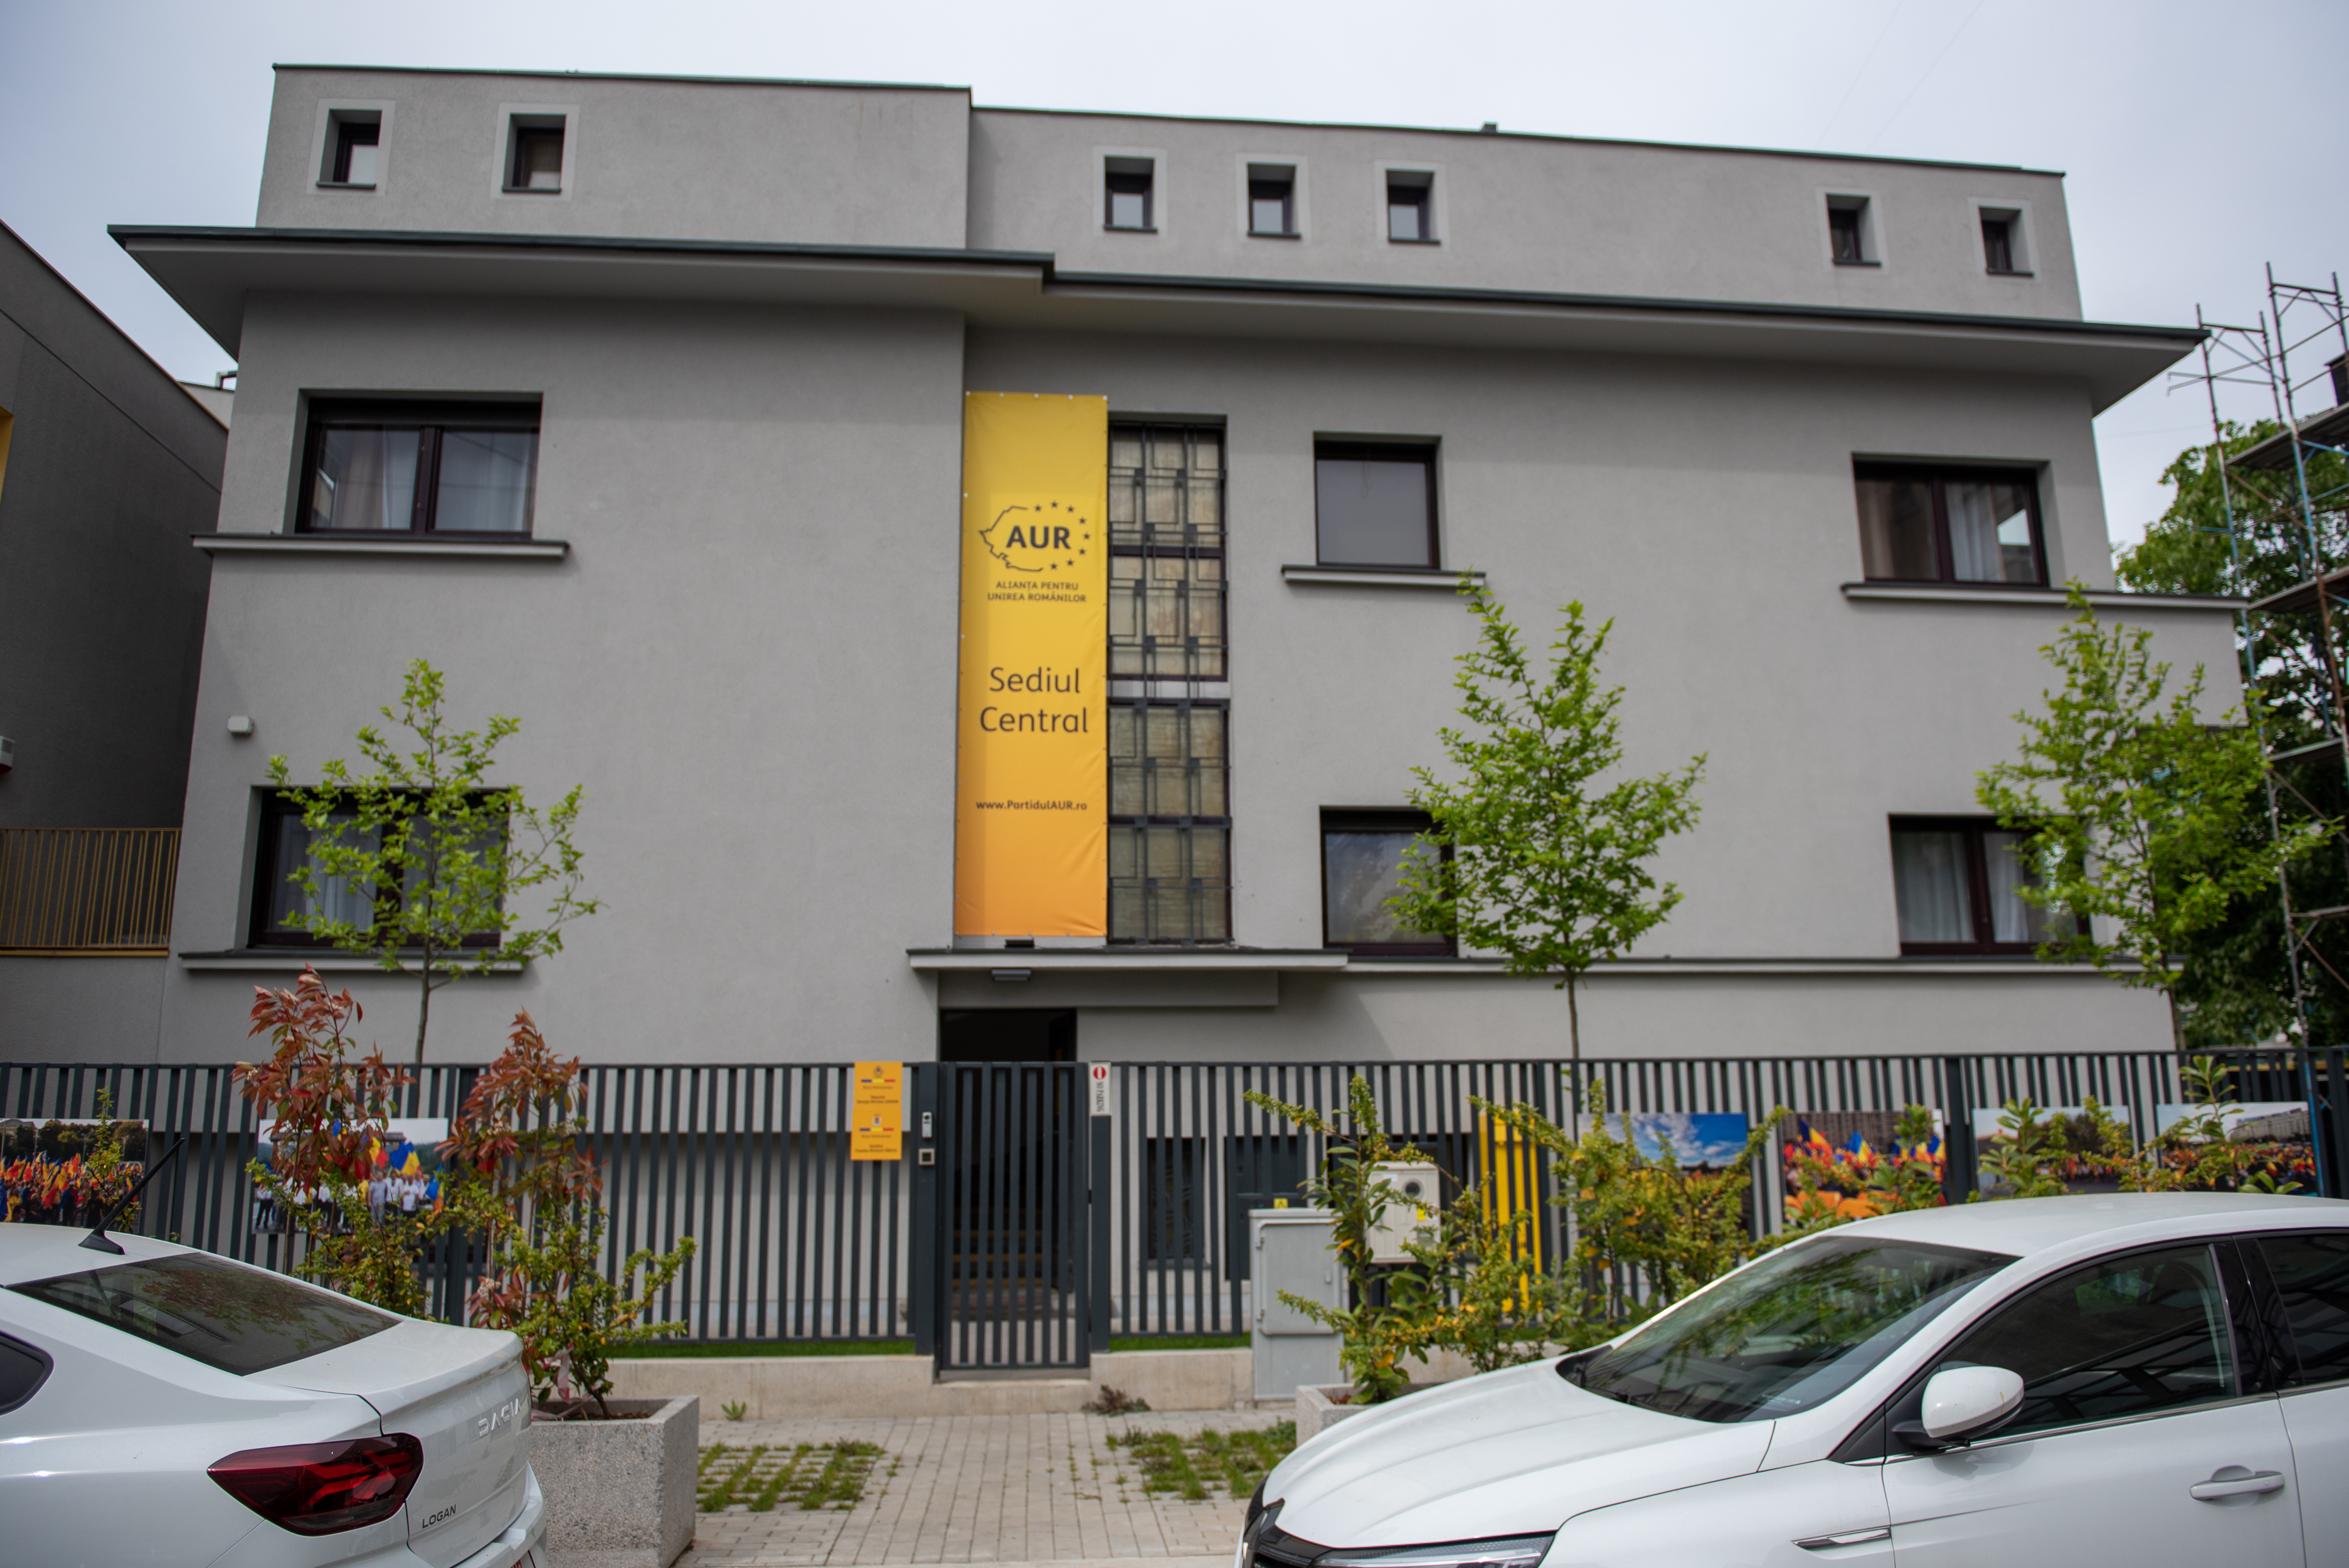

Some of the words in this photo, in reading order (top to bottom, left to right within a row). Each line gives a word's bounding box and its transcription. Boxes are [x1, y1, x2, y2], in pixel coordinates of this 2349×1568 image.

[1006, 525, 1071, 549] AUR
[987, 592, 1026, 601] UNIREA
[1027, 591, 1087, 602] ROMÂNILOR
[1041, 581, 1079, 590] PENTRU
[989, 666, 1080, 693] Sediul
[980, 706, 1088, 733] Central
[976, 800, 1088, 810] www.PartidulAUR.ro
[478, 1397, 522, 1438] DACIA
[422, 1504, 457, 1528] LOGAN
